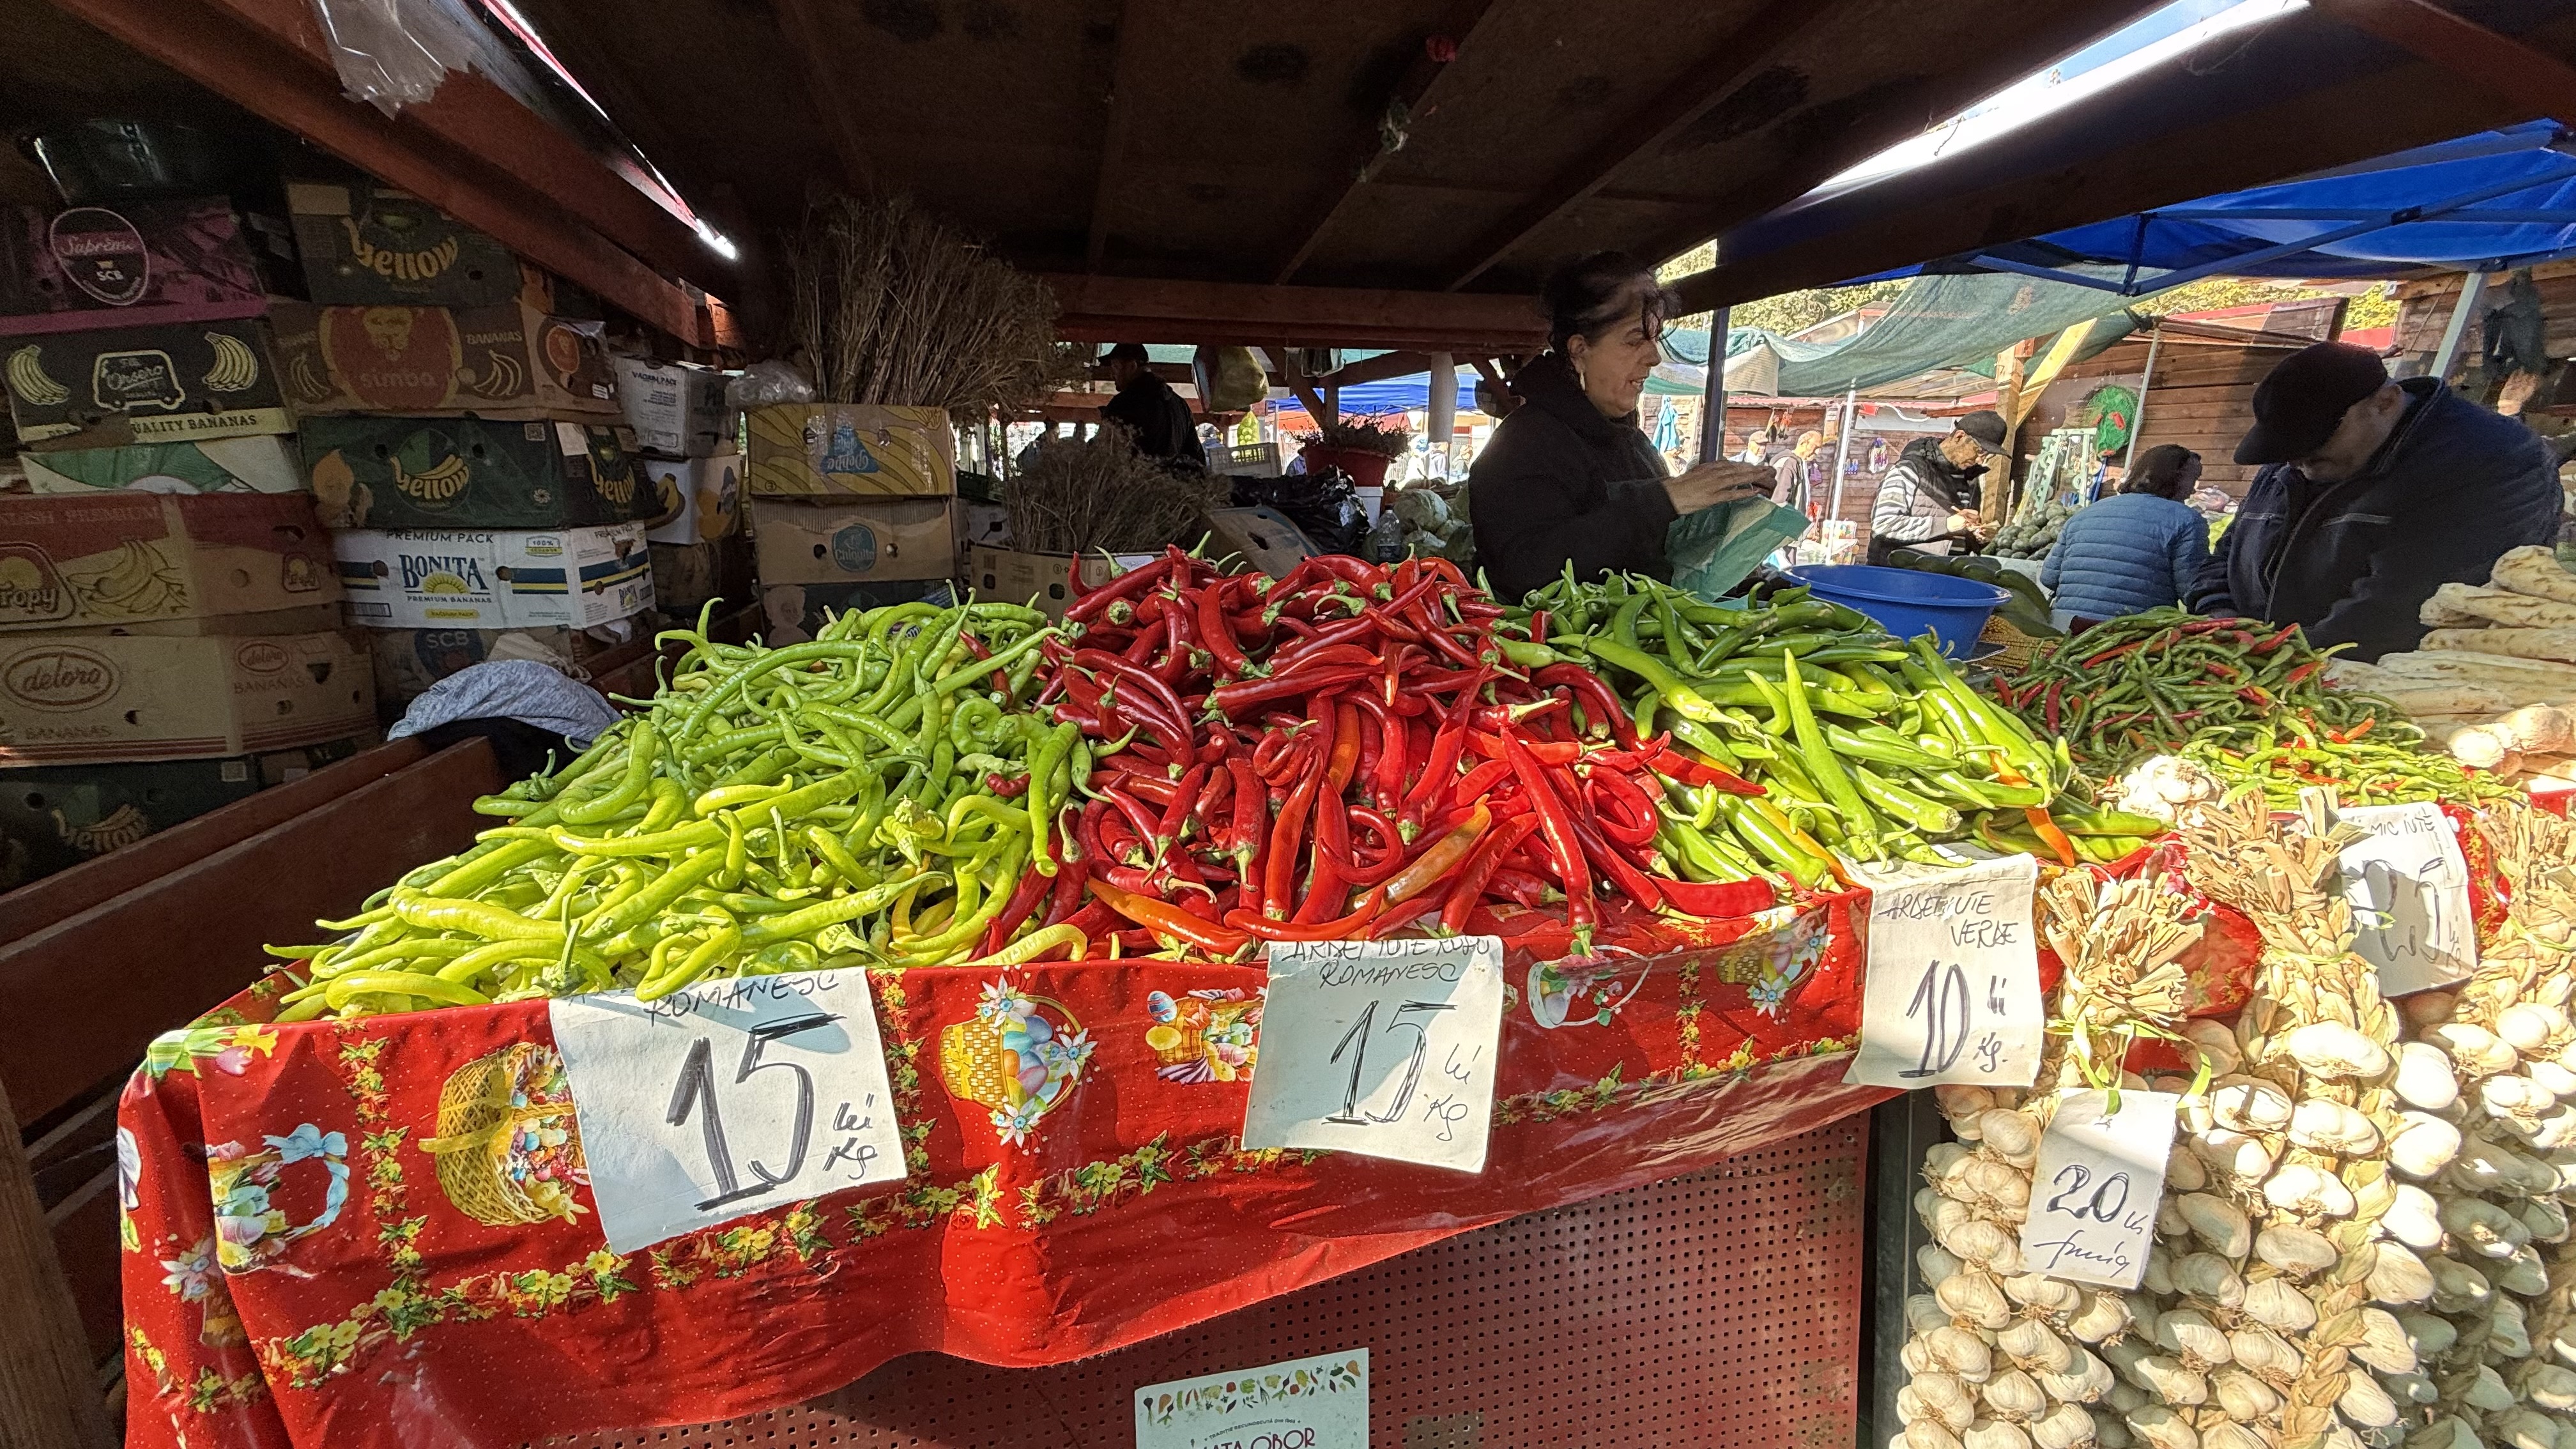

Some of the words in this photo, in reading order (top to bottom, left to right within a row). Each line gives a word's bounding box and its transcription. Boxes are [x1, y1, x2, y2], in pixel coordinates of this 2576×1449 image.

[464, 331, 523, 345] BANANAS
[131, 420, 184, 435] UALITY
[188, 415, 257, 430] BANANAS
[390, 456, 470, 500] yellow
[387, 530, 451, 542] PREMIUM
[457, 533, 494, 544] PACK
[398, 554, 489, 590] BONITA
[0, 579, 59, 613] ropy
[426, 631, 470, 649] SCB
[234, 676, 305, 694] BANANAS
[26, 725, 113, 740] BANANAS
[1319, 959, 1460, 990] ROMANESC
[1897, 960, 1972, 1078] 10
[1321, 999, 1458, 1126] 15
[666, 1013, 847, 1212] 15
[2046, 1164, 2130, 1223] 20
[1250, 1427, 1316, 1449] OBOR
